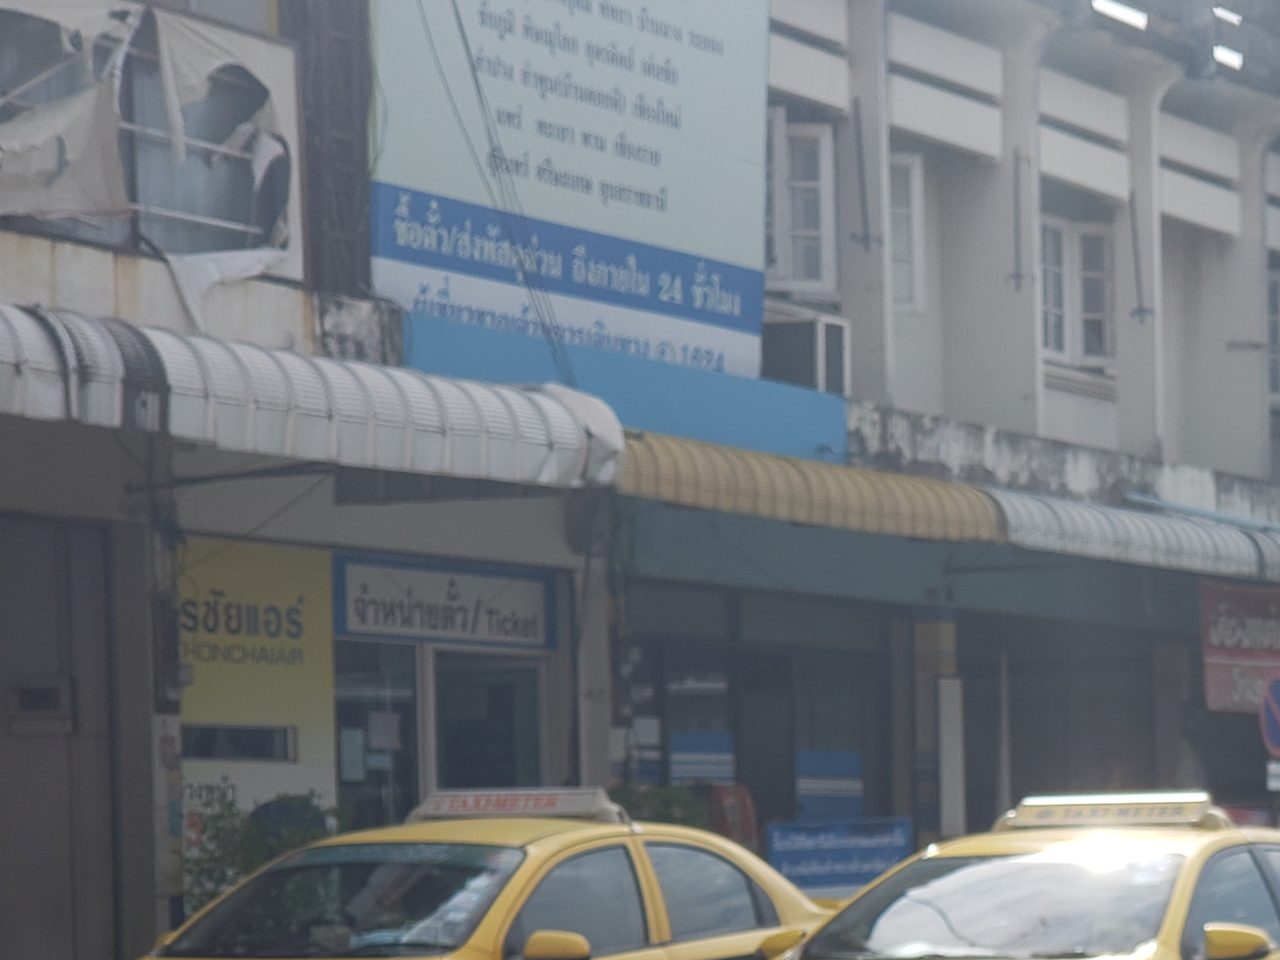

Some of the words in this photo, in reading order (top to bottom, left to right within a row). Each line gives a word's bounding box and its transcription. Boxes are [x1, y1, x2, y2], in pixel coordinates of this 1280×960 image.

[657, 271, 684, 305] 24
[691, 257, 742, 317] ชั่วโมง
